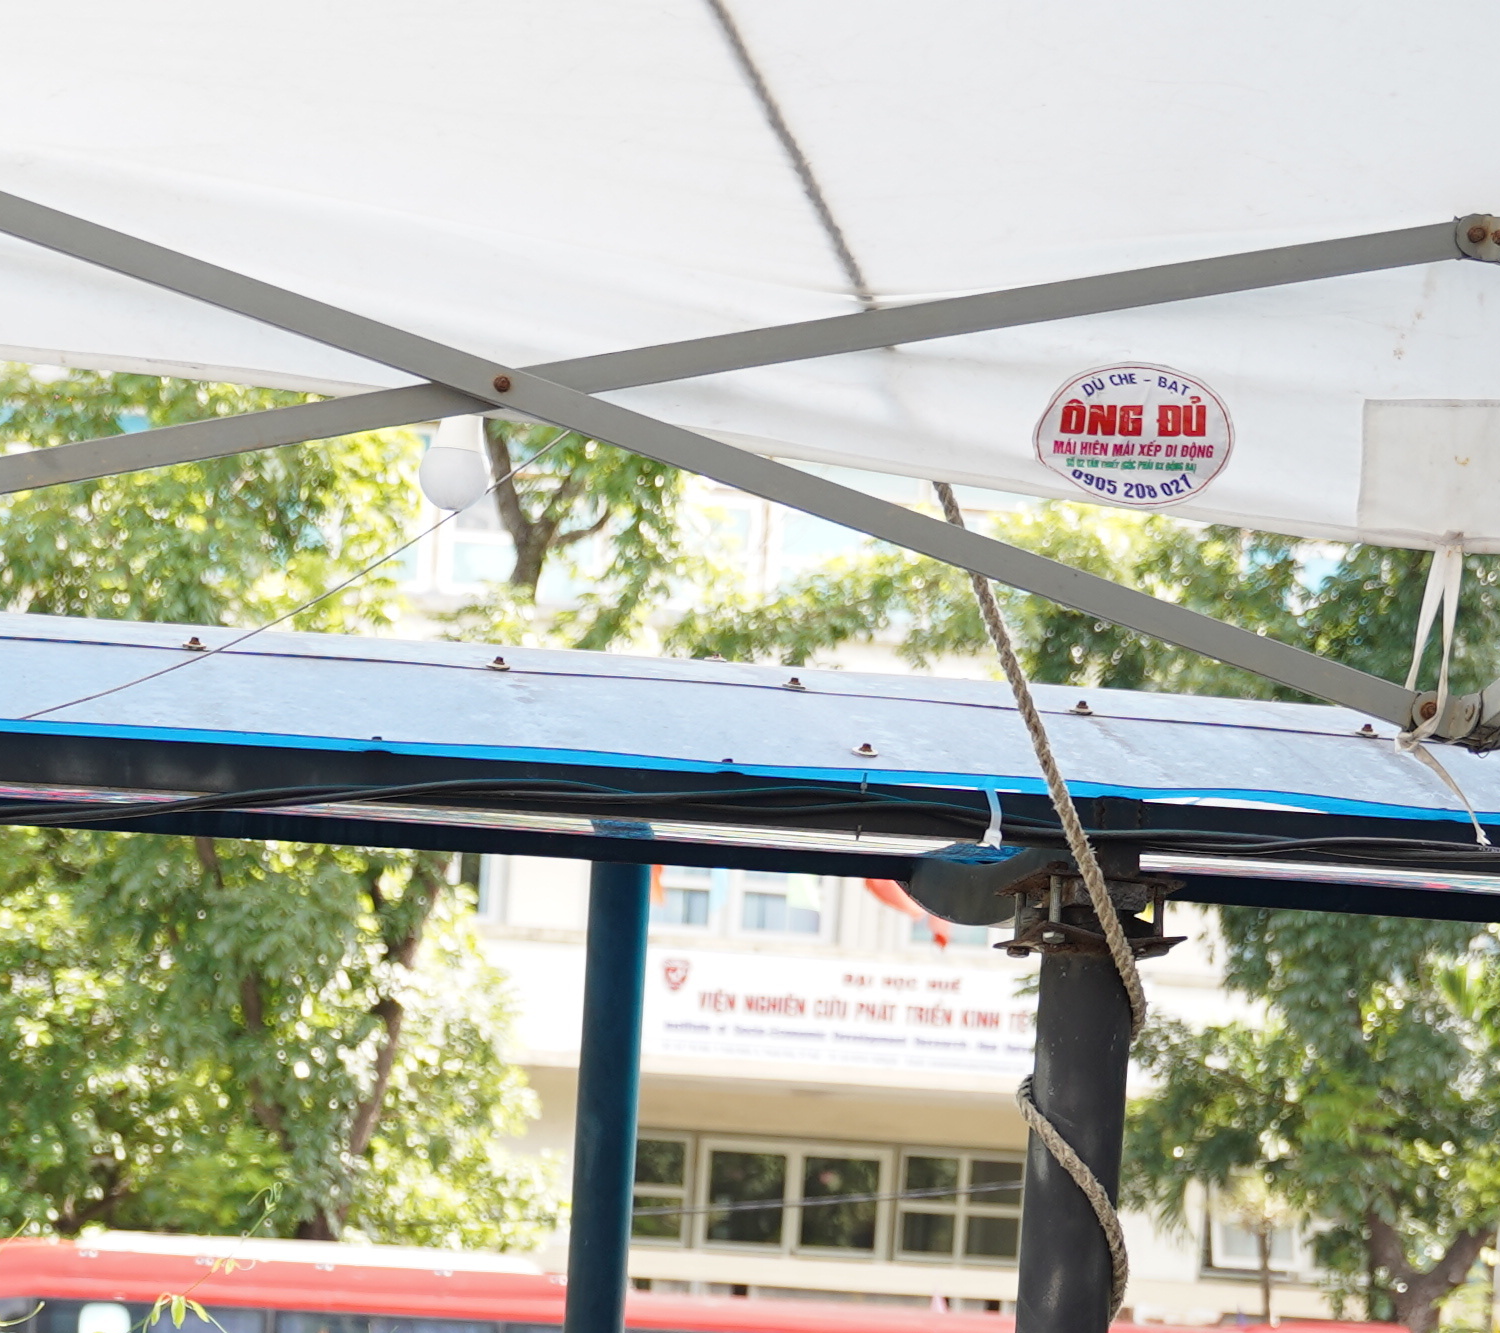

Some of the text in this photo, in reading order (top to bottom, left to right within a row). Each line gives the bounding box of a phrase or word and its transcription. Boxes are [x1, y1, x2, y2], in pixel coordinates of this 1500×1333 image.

[1081, 376, 1106, 397] DÙ
[1109, 373, 1137, 386] CHE
[1158, 376, 1190, 397] BẠT
[1060, 396, 1207, 437] ÔNG ĐỦ
[1053, 440, 1214, 461] MÁI HIÊN MÁI XẾP DI ĐỘNG
[1071, 469, 1193, 499] 0905 208 021
[745, 993, 805, 1015] NGHIÊN
[961, 1010, 999, 1028] KINH
